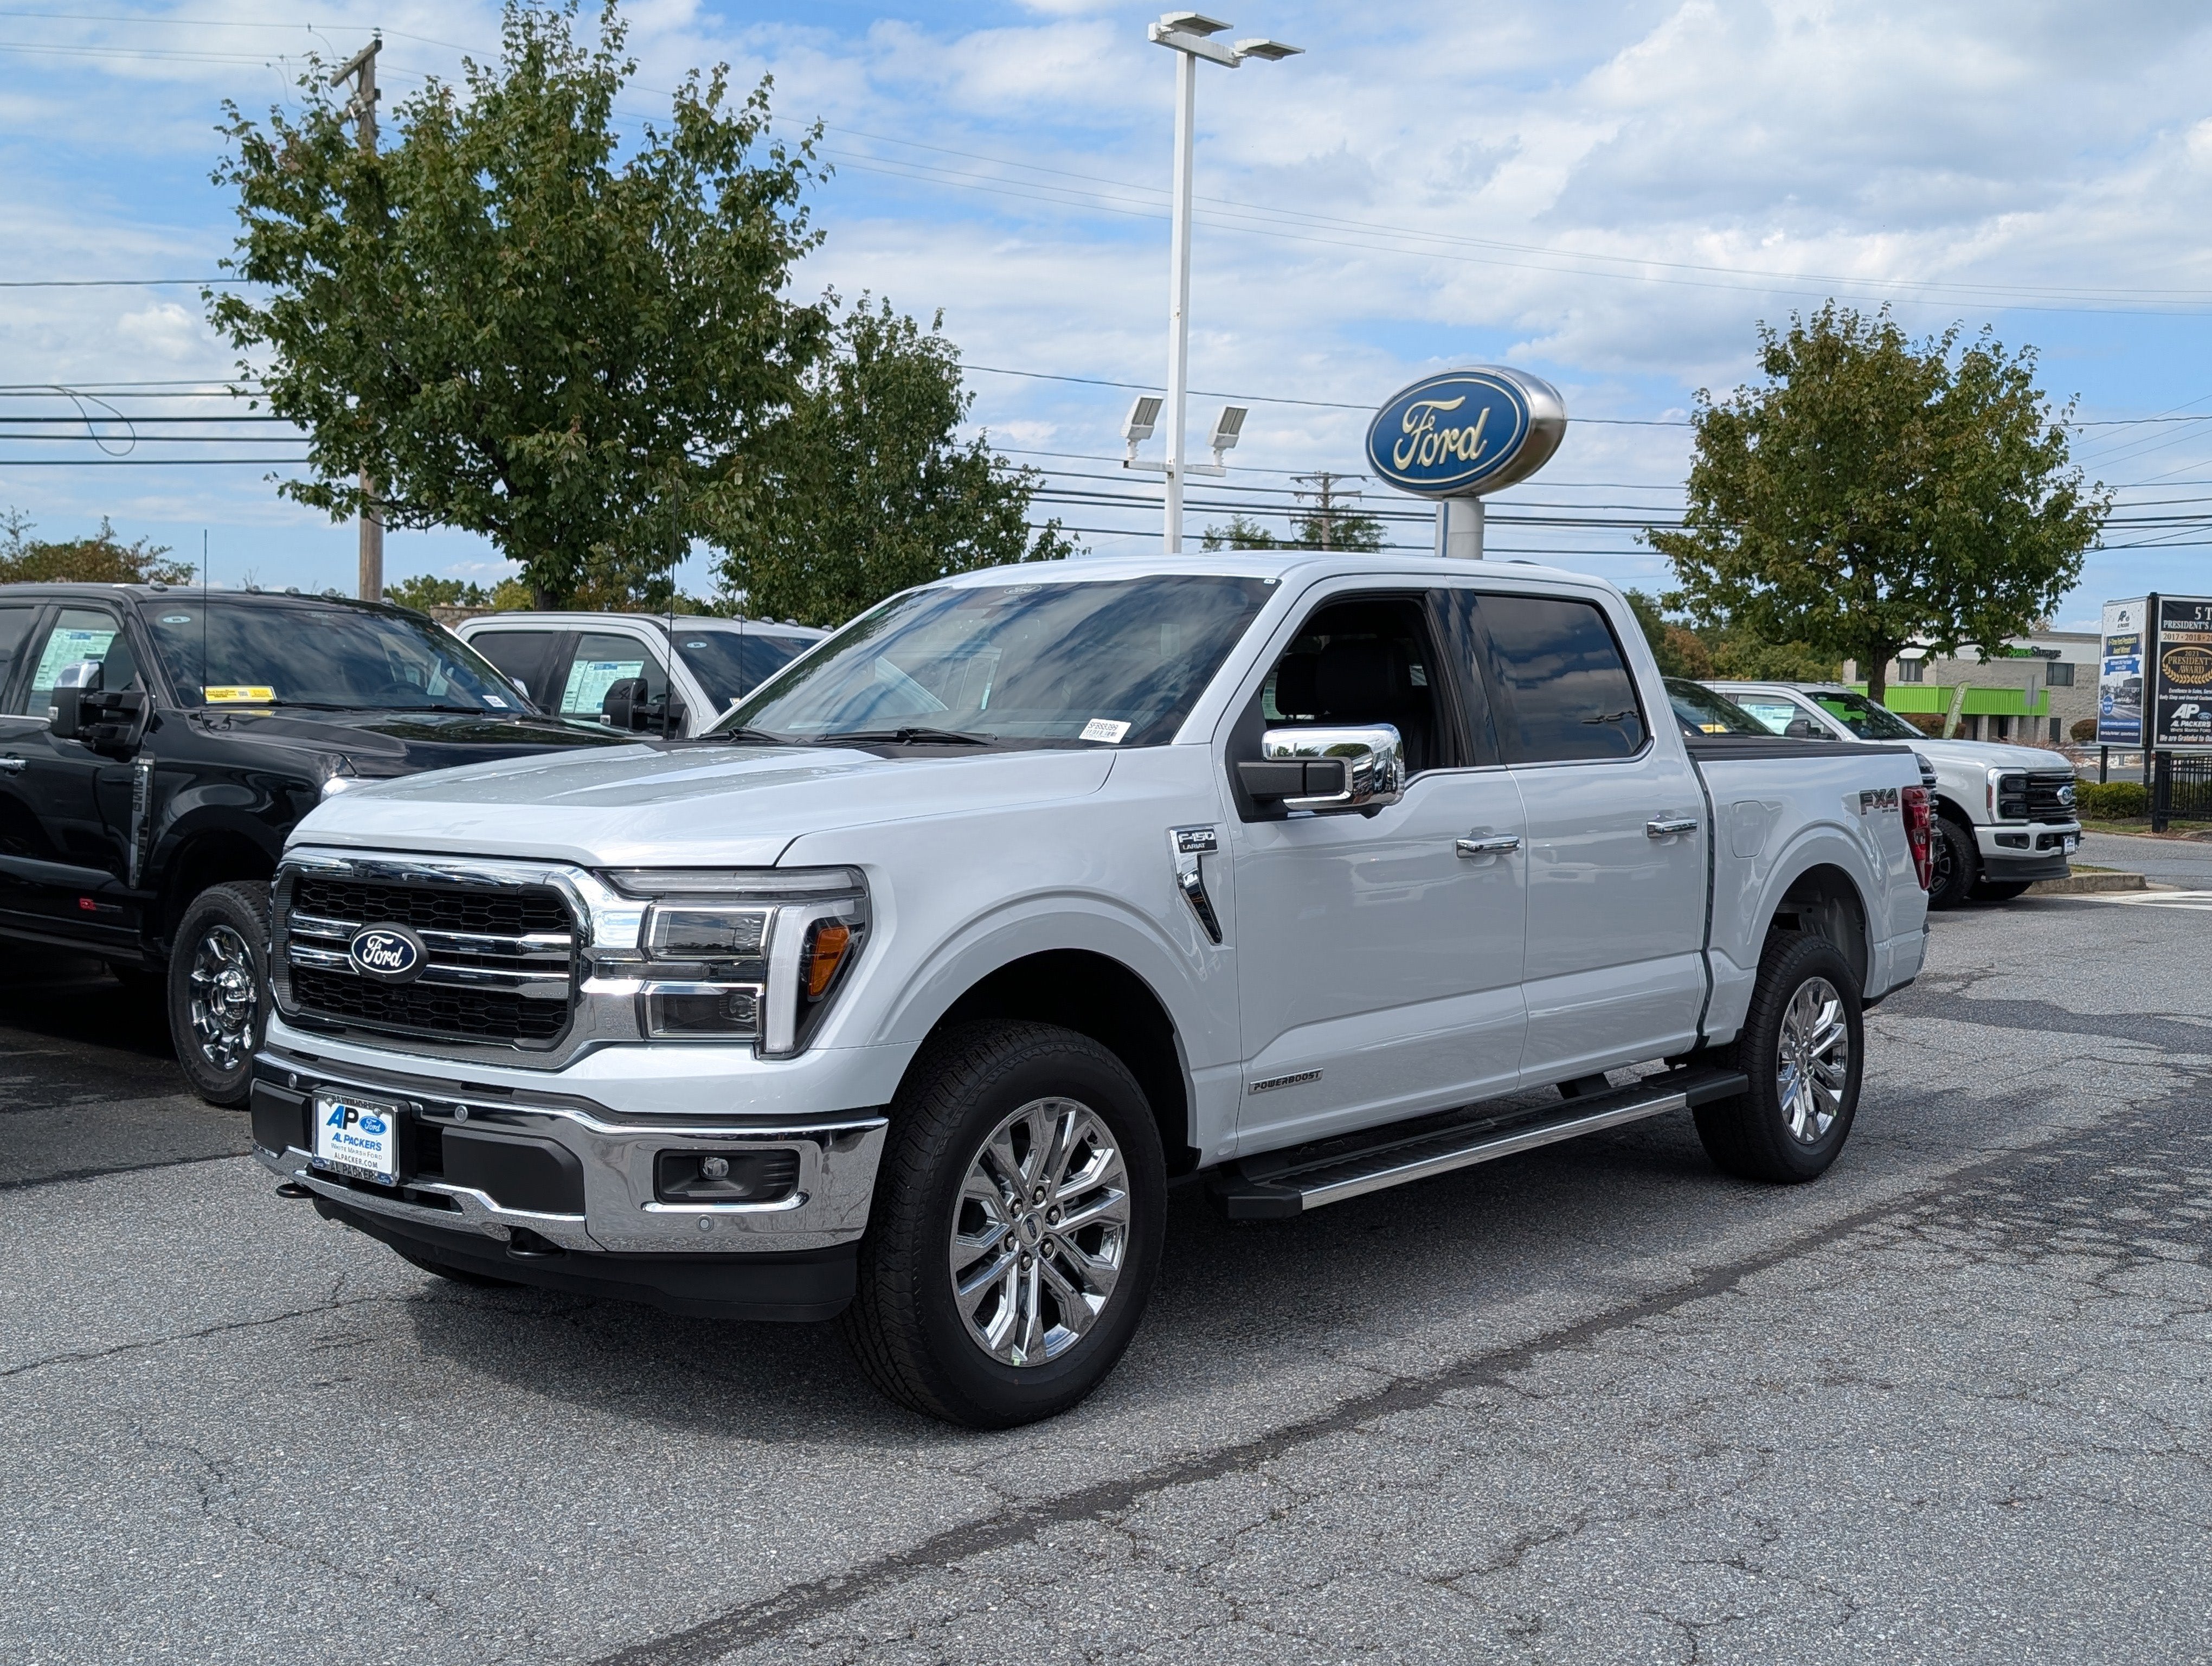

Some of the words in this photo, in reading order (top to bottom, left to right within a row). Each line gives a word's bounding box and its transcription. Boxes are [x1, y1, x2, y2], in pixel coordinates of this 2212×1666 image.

[1393, 395, 1491, 471] Ford
[2194, 606, 2202, 620] 5
[2163, 620, 2209, 630] PRESIDENT'S
[2168, 656, 2212, 665] PRESIDENT'
[2178, 665, 2204, 674] AWARD
[2170, 703, 2200, 719] AP
[1859, 788, 1899, 815] FX4
[1178, 831, 1216, 843] F-150
[363, 935, 404, 967] Ford
[1254, 1070, 1321, 1091] POWERBOOST
[326, 1104, 359, 1130] AP
[364, 1117, 381, 1132] Ford
[332, 1132, 343, 1143] AL
[343, 1134, 382, 1151] PACKER'S
[334, 1152, 378, 1169] ALPACKER.COM
